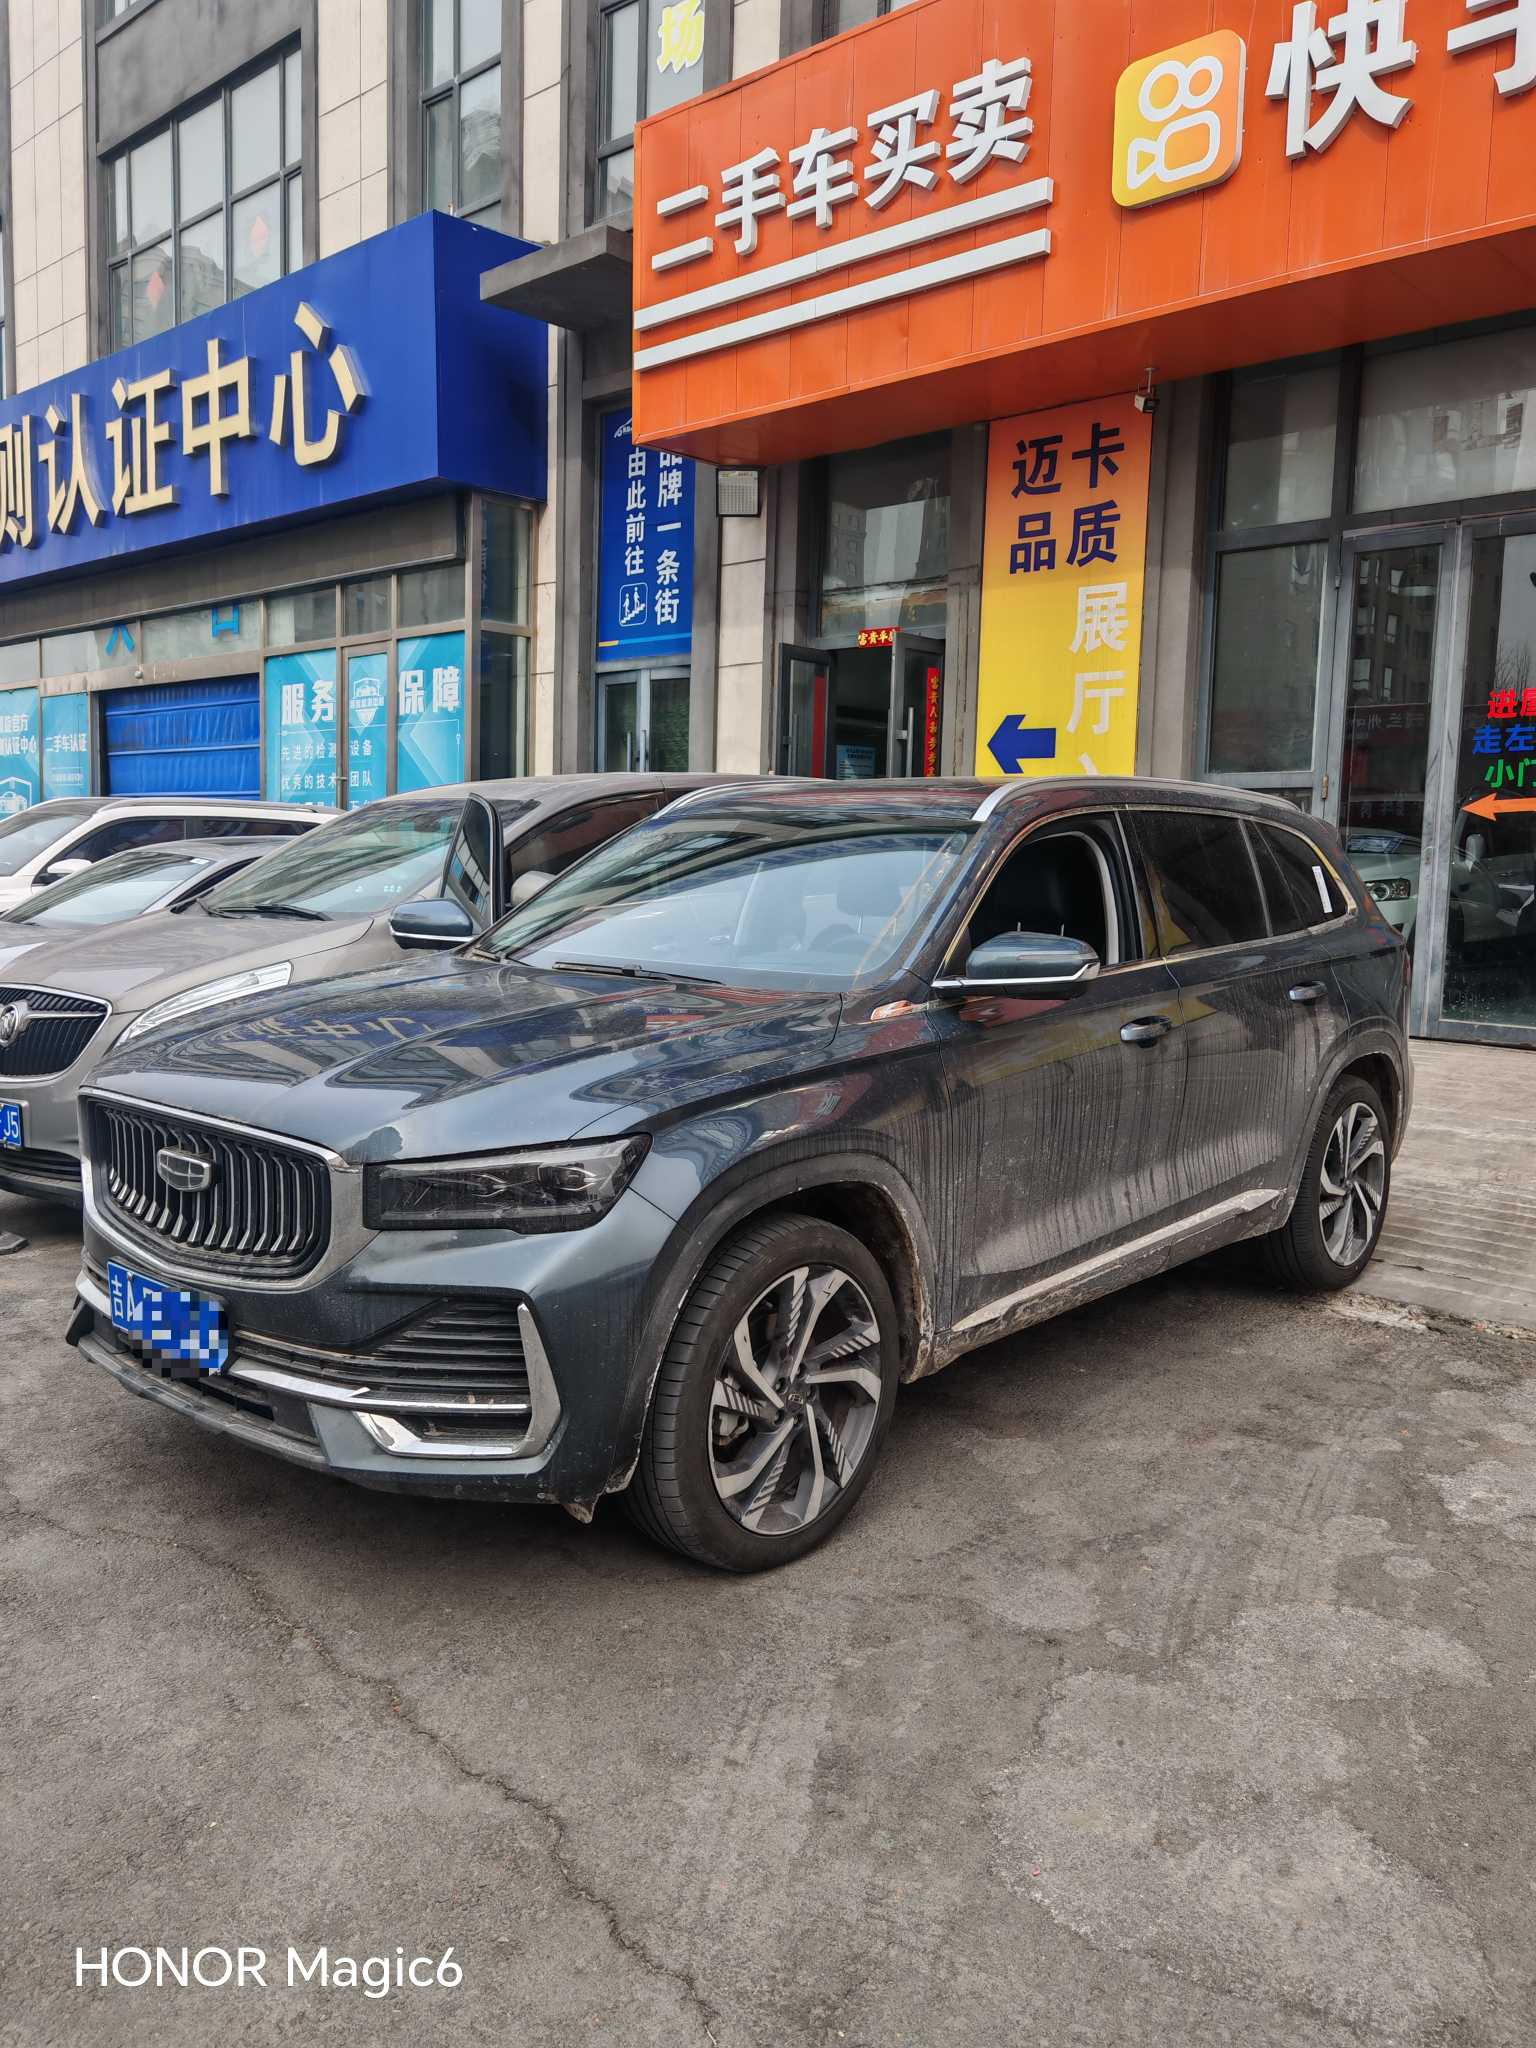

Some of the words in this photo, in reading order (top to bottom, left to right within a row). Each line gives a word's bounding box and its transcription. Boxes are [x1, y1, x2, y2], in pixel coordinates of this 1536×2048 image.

[656, 0, 704, 73] 场
[651, 57, 1035, 272] 二手车买卖
[624, 447, 647, 577] 由此前往
[45, 733, 88, 753] 二手车认证
[1472, 724, 1536, 755] 走左
